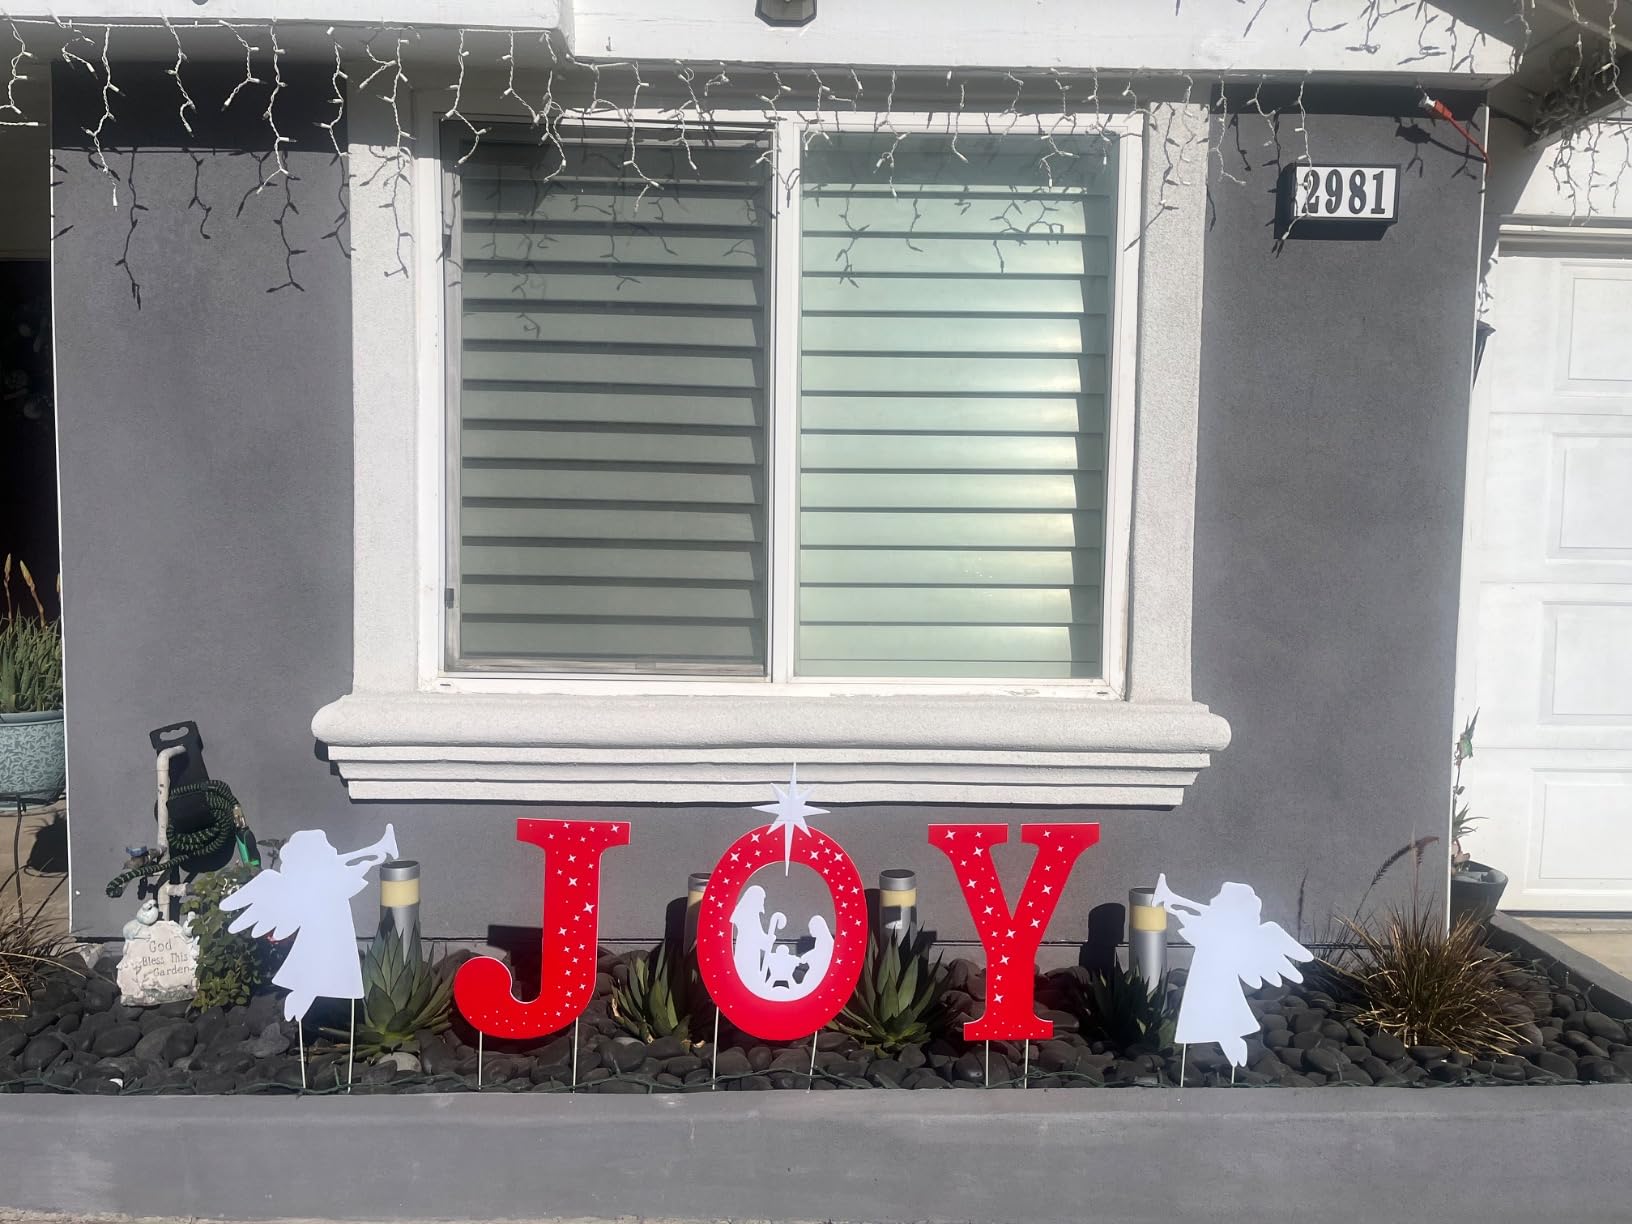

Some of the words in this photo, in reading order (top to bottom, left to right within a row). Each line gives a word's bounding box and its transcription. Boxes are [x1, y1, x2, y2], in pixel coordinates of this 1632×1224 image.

[1302, 169, 1385, 215] 2981
[454, 817, 1100, 1042] JOY
[149, 940, 173, 953] God
[142, 956, 165, 967] Bless
[171, 952, 189, 964] This
[153, 965, 190, 977] Garden
